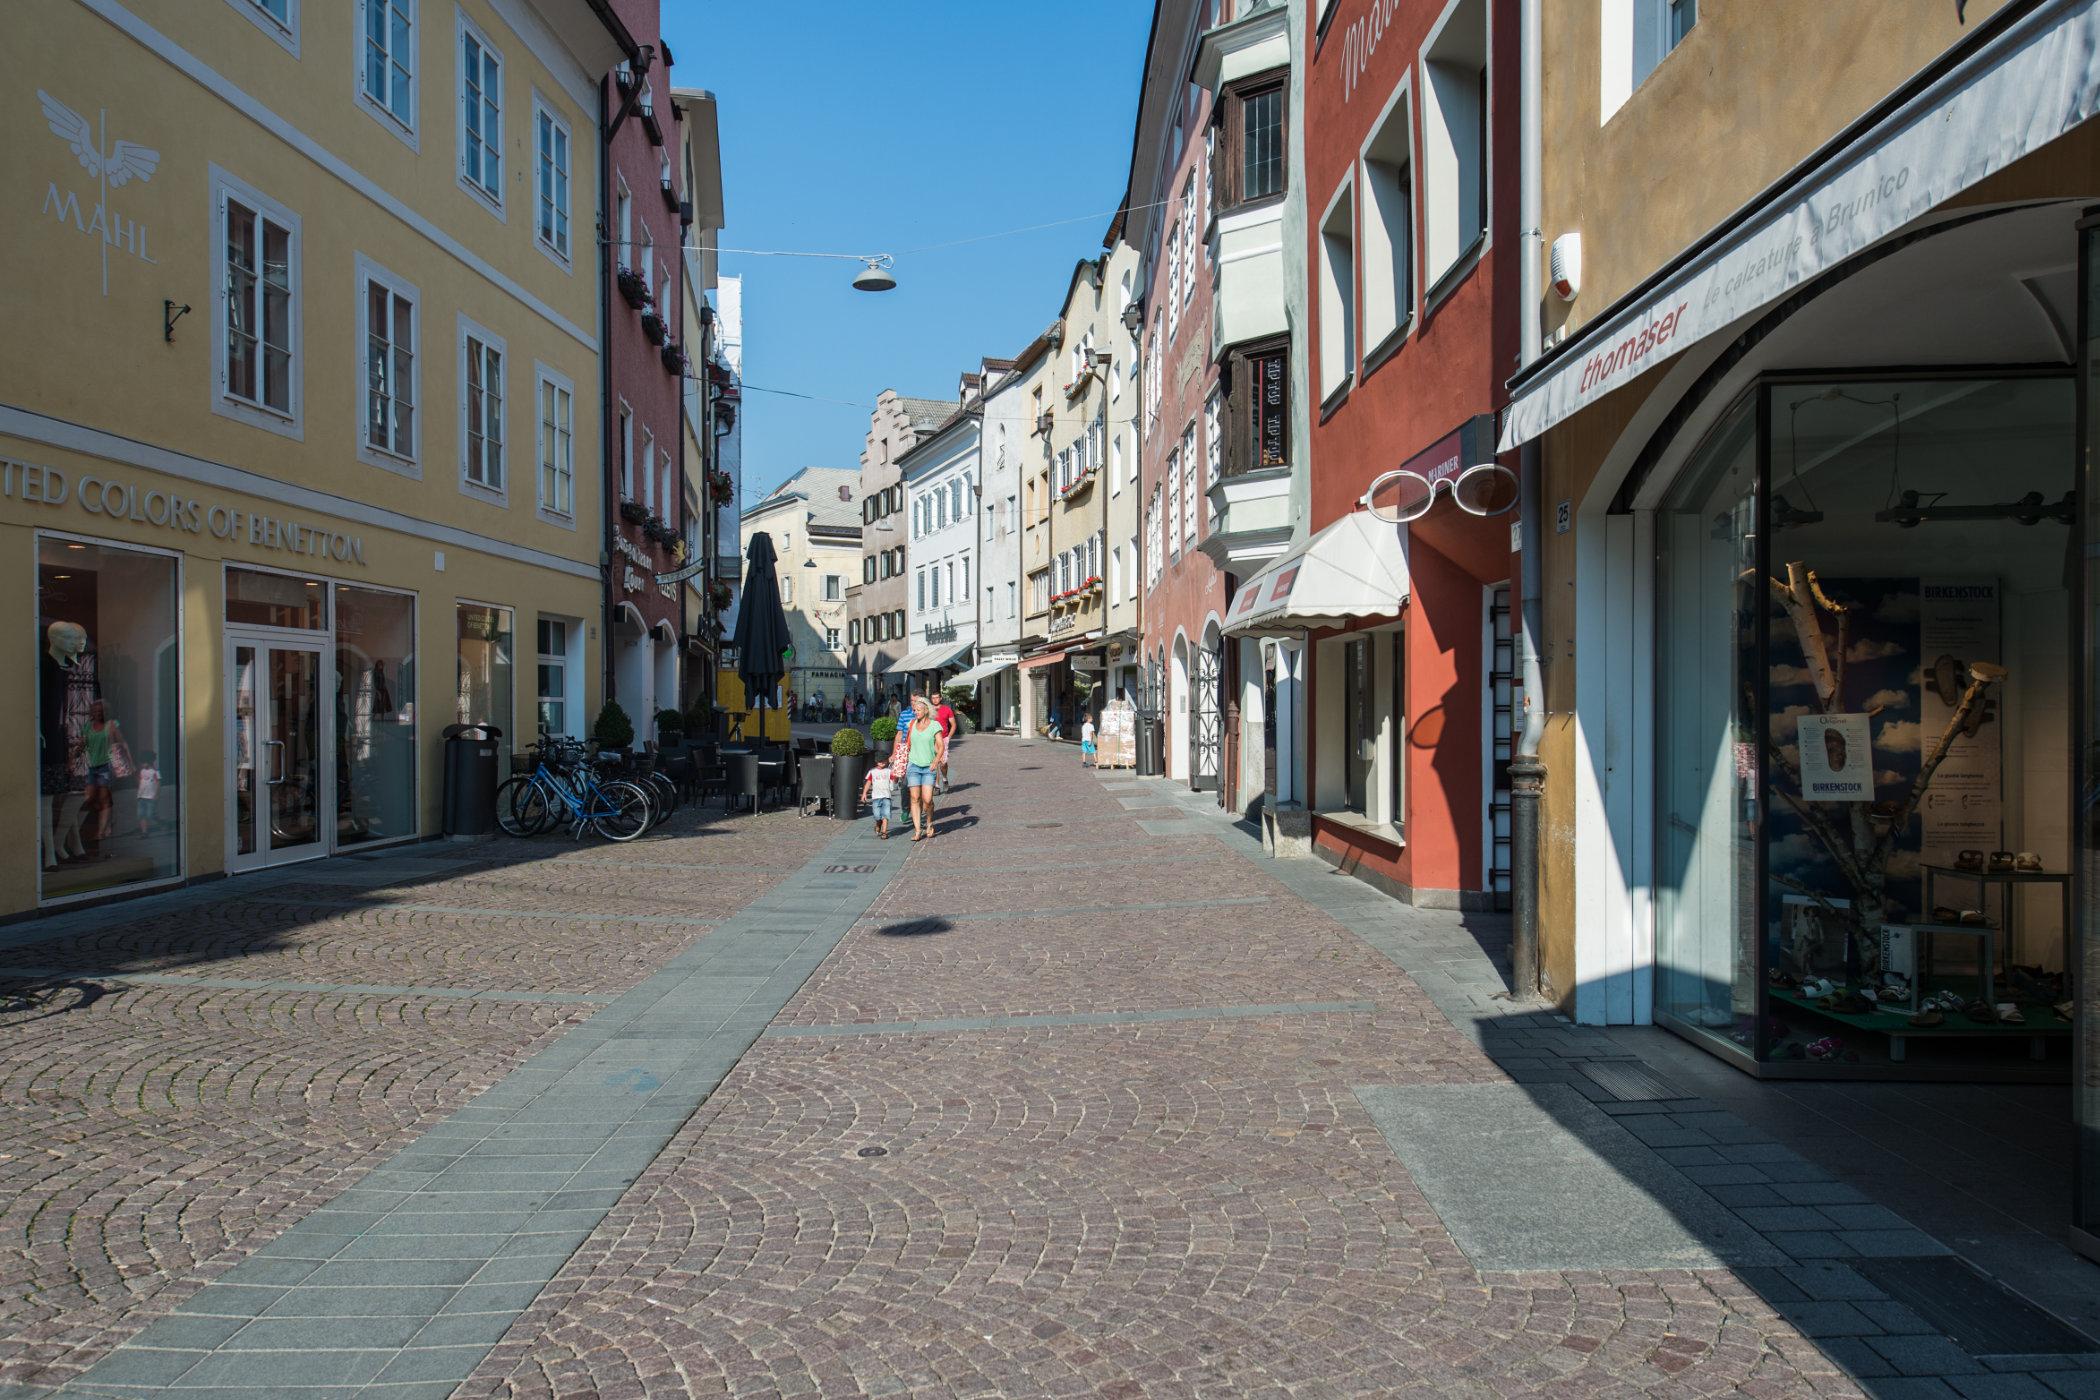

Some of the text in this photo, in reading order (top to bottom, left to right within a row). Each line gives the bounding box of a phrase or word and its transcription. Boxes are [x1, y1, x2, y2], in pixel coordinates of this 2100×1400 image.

[42, 180, 158, 265] MAHL
[1580, 165, 1910, 394] thomaser Le calzature a Brunico
[1428, 455, 1459, 483] MARINER
[78, 475, 200, 533] COLORS
[207, 503, 244, 541] OF
[1558, 504, 1569, 525] 25
[661, 564, 700, 582] PIZZERIA
[1924, 585, 1994, 599] BIRKENSTOCK
[811, 671, 846, 679] FARMACIA
[1812, 782, 1863, 792] BIRKENSTOCK
[1882, 929, 1890, 970] BIRKENSTOCK
